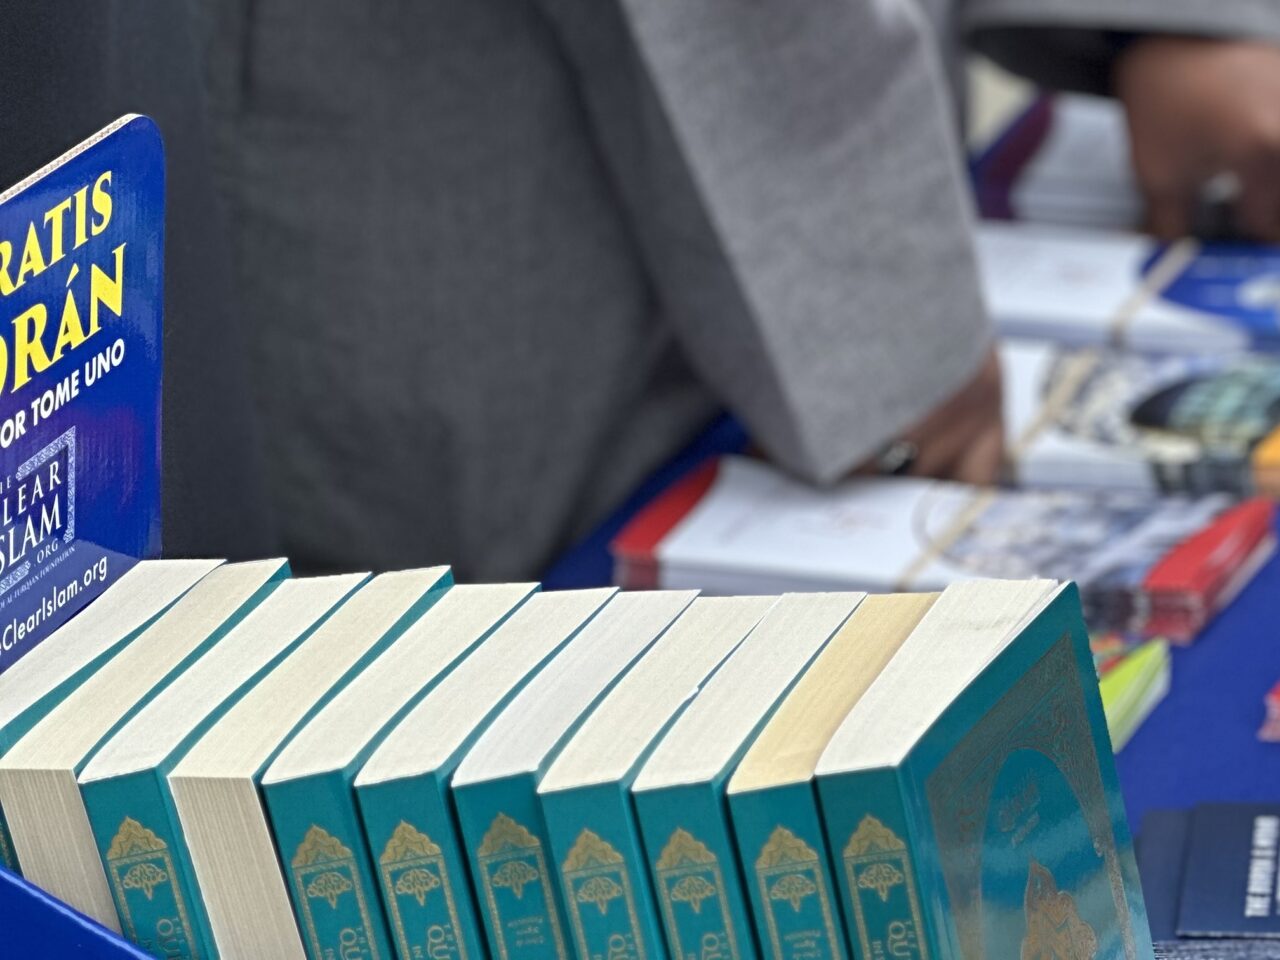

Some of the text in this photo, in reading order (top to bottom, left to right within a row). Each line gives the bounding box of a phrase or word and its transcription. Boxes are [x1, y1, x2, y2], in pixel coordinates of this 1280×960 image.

[0, 242, 127, 396] RÁN
[31, 369, 80, 427] TOME
[84, 338, 125, 387] UNO
[0, 556, 107, 655] ClearIslam.org
